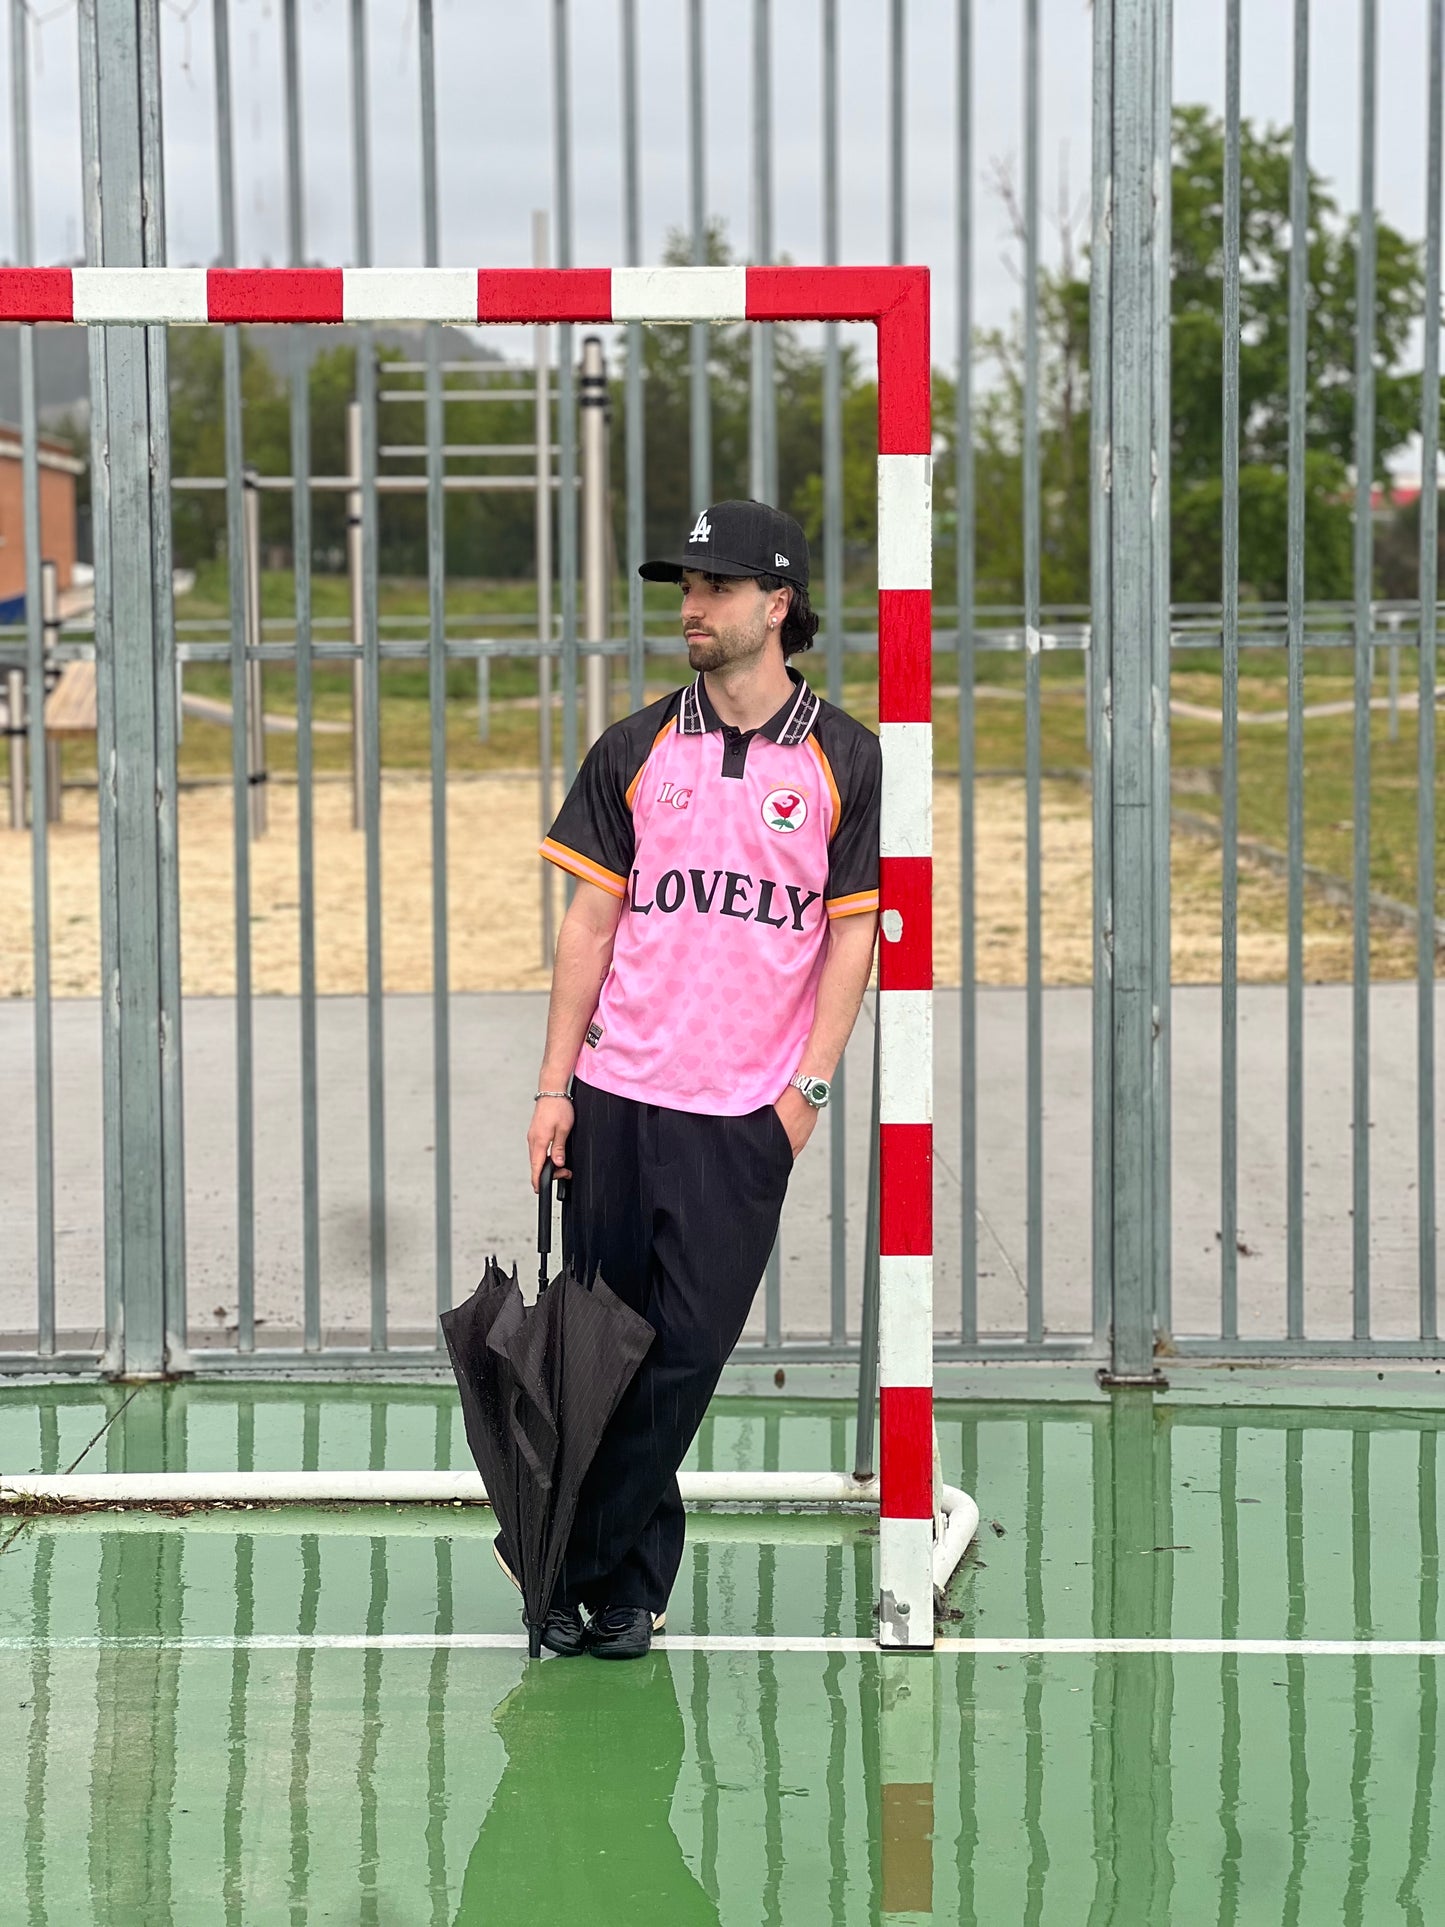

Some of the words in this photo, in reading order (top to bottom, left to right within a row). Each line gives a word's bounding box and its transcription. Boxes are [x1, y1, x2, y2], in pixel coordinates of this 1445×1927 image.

[689, 510, 711, 543] LA
[657, 782, 692, 809] LC
[631, 869, 821, 931] LOVELY
